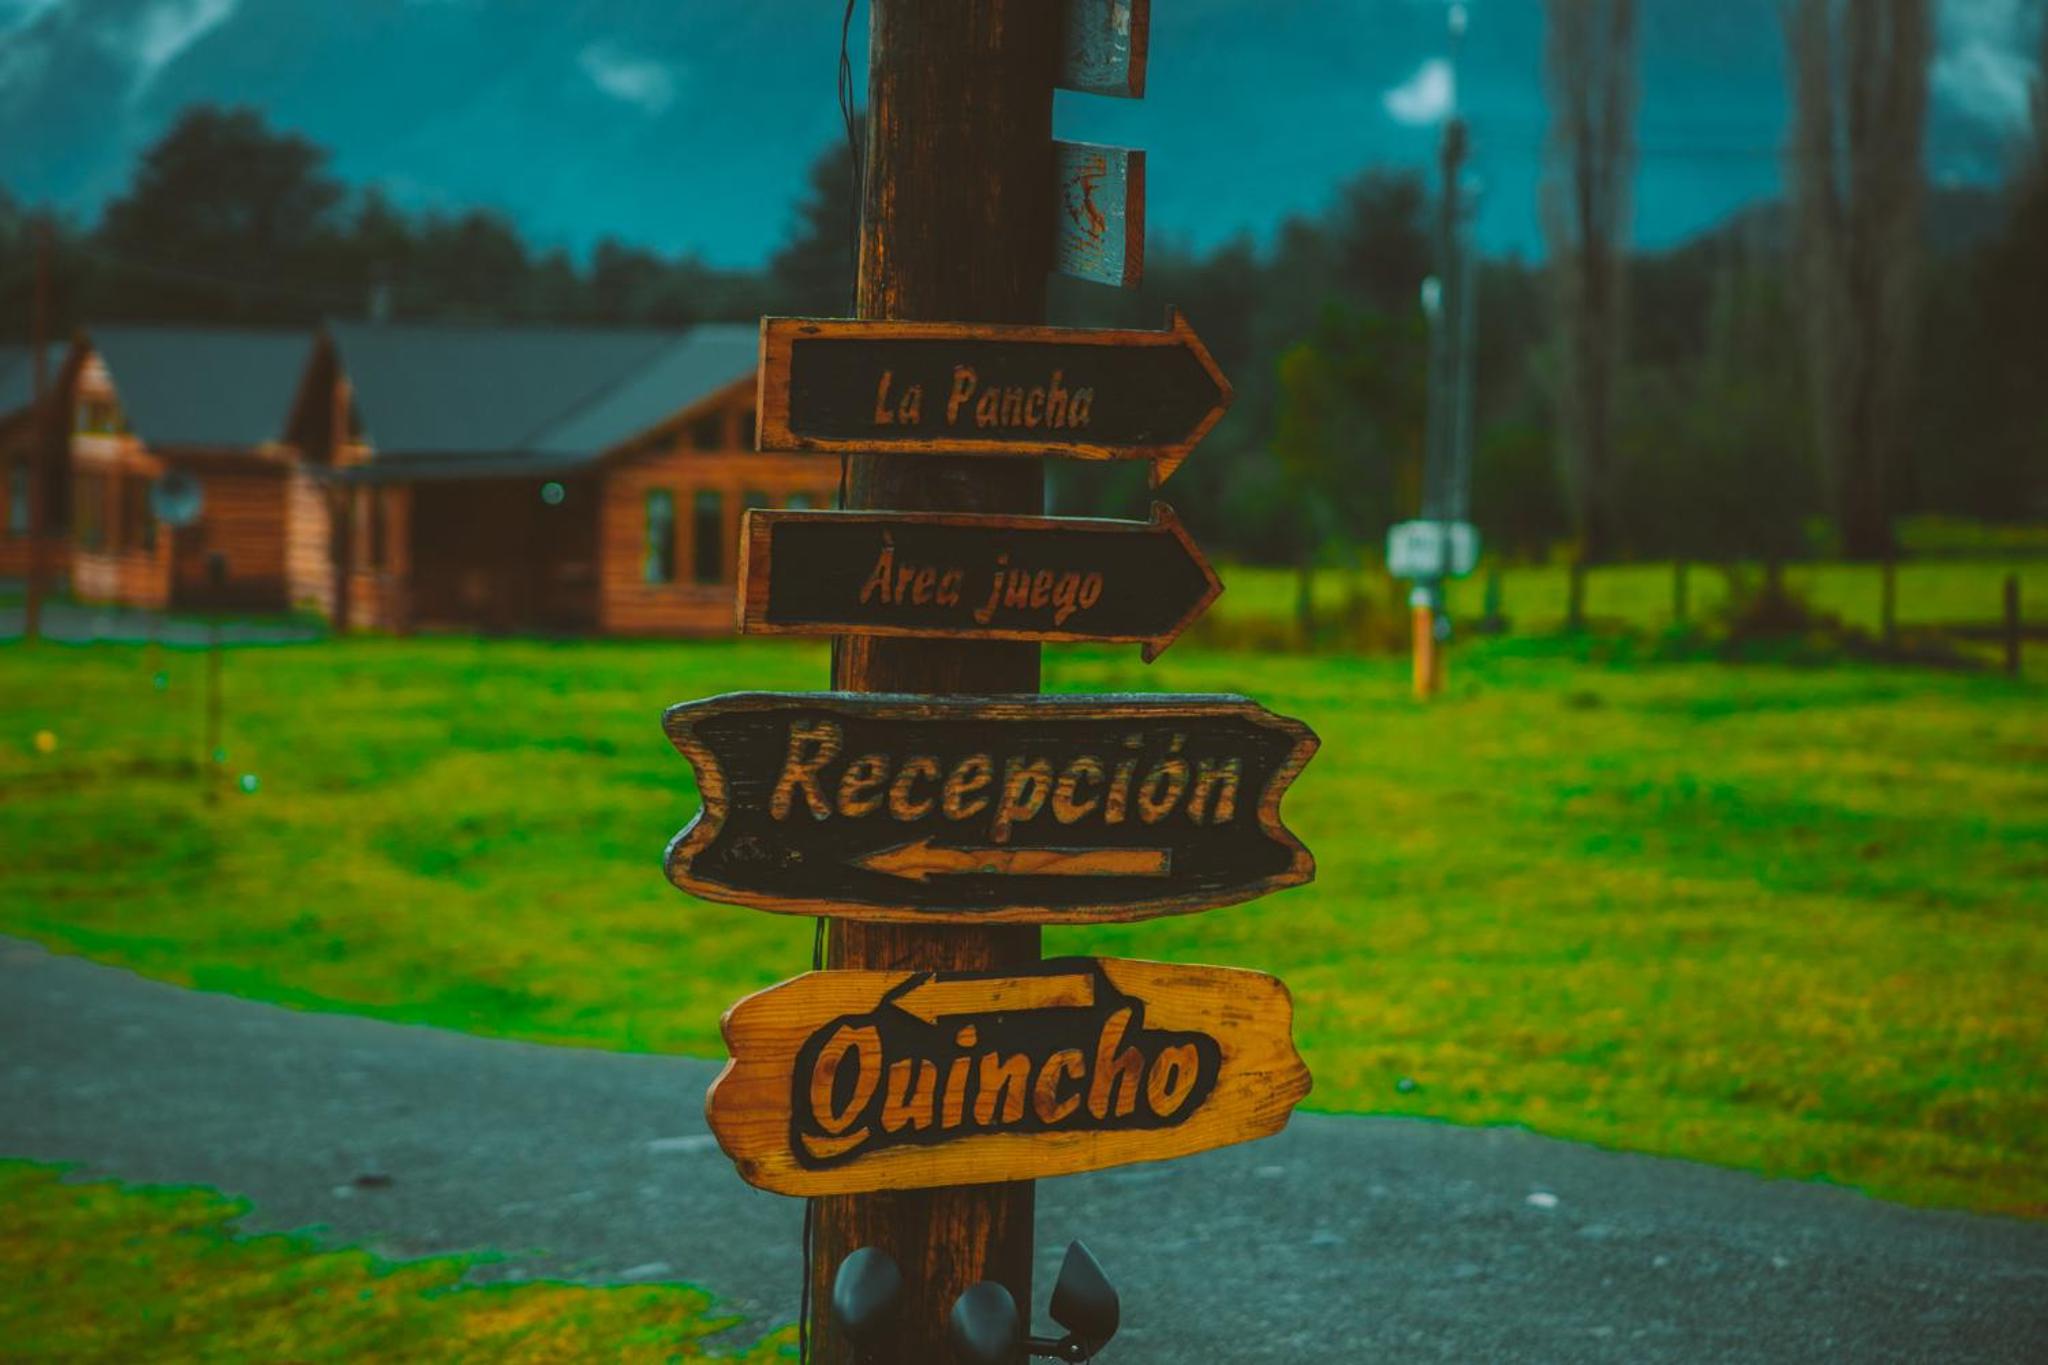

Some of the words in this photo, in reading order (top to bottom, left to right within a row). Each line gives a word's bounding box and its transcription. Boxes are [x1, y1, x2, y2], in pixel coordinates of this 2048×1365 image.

[875, 370, 923, 426] La
[946, 364, 1094, 429] Pancha
[974, 554, 1104, 626] juego
[770, 720, 1240, 843] Recepción
[801, 1009, 1199, 1158] Quincho
